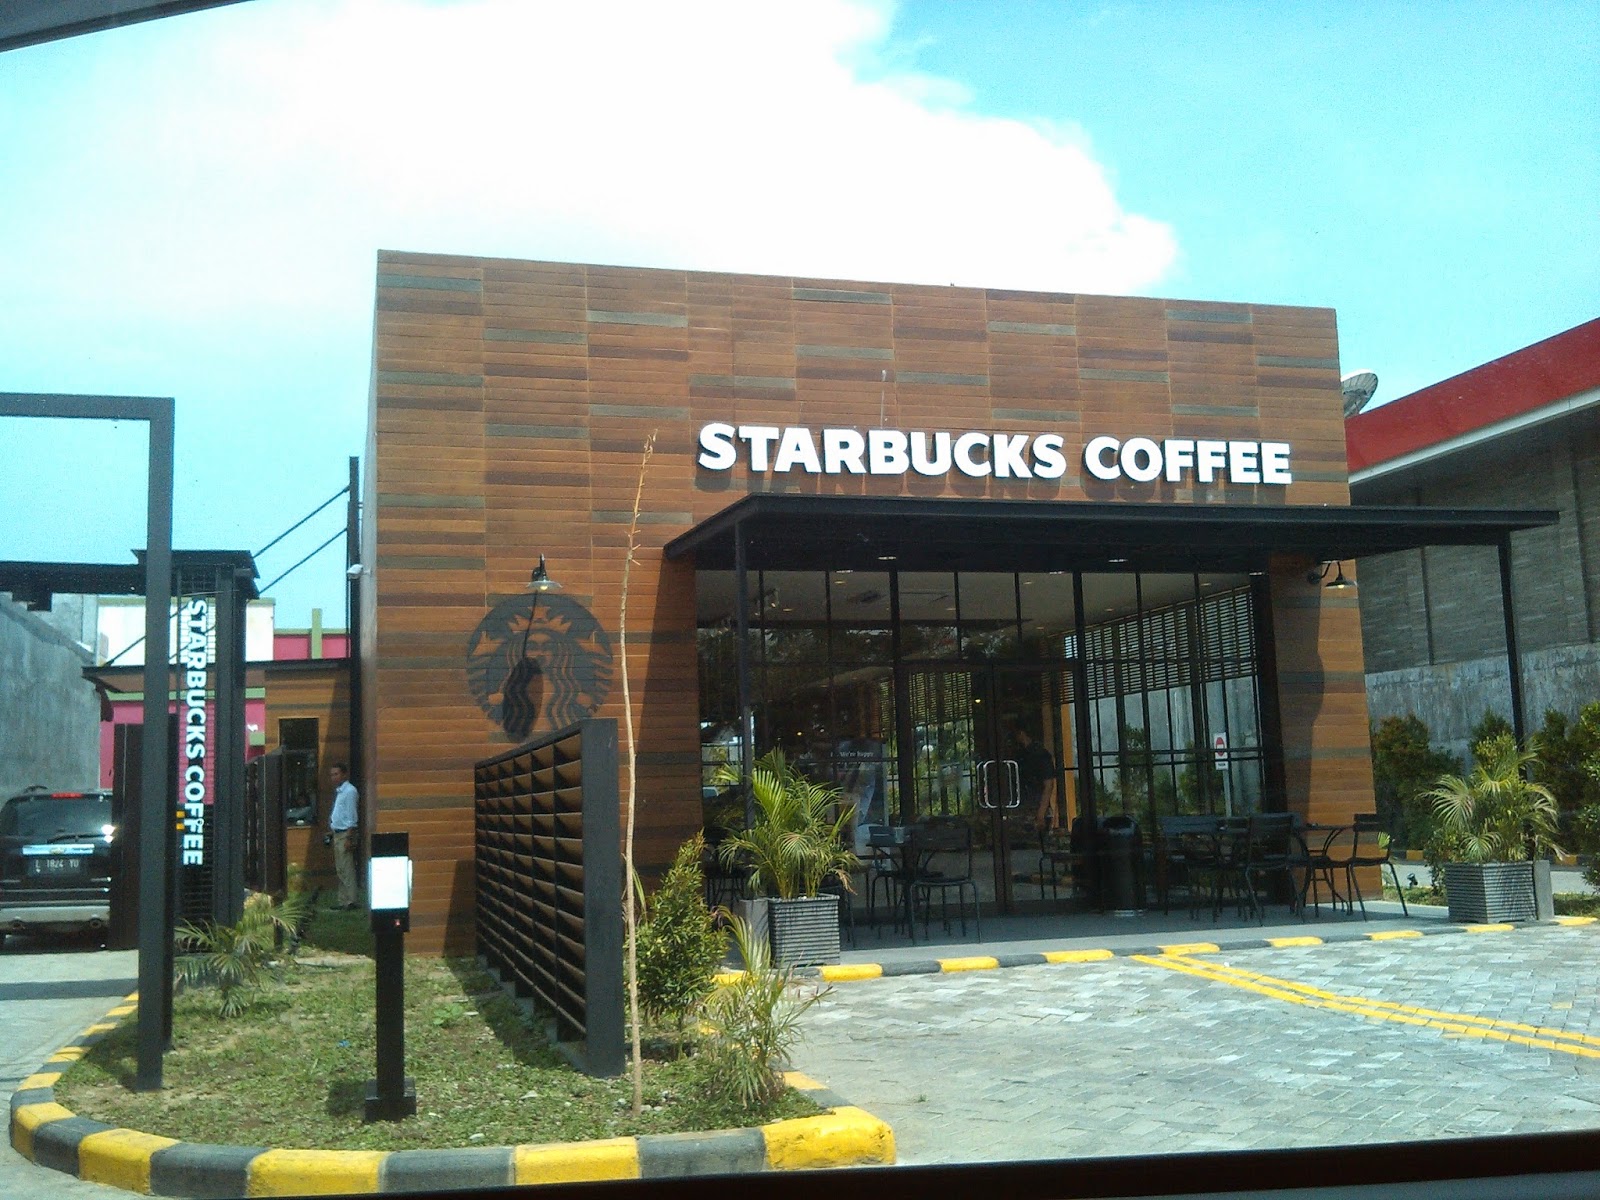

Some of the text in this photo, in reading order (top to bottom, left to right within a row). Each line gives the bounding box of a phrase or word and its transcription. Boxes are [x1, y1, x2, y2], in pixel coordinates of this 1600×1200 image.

[698, 422, 1293, 485] STARBUCKS COFFEE
[183, 600, 207, 865] STARBUCKS COFFEE
